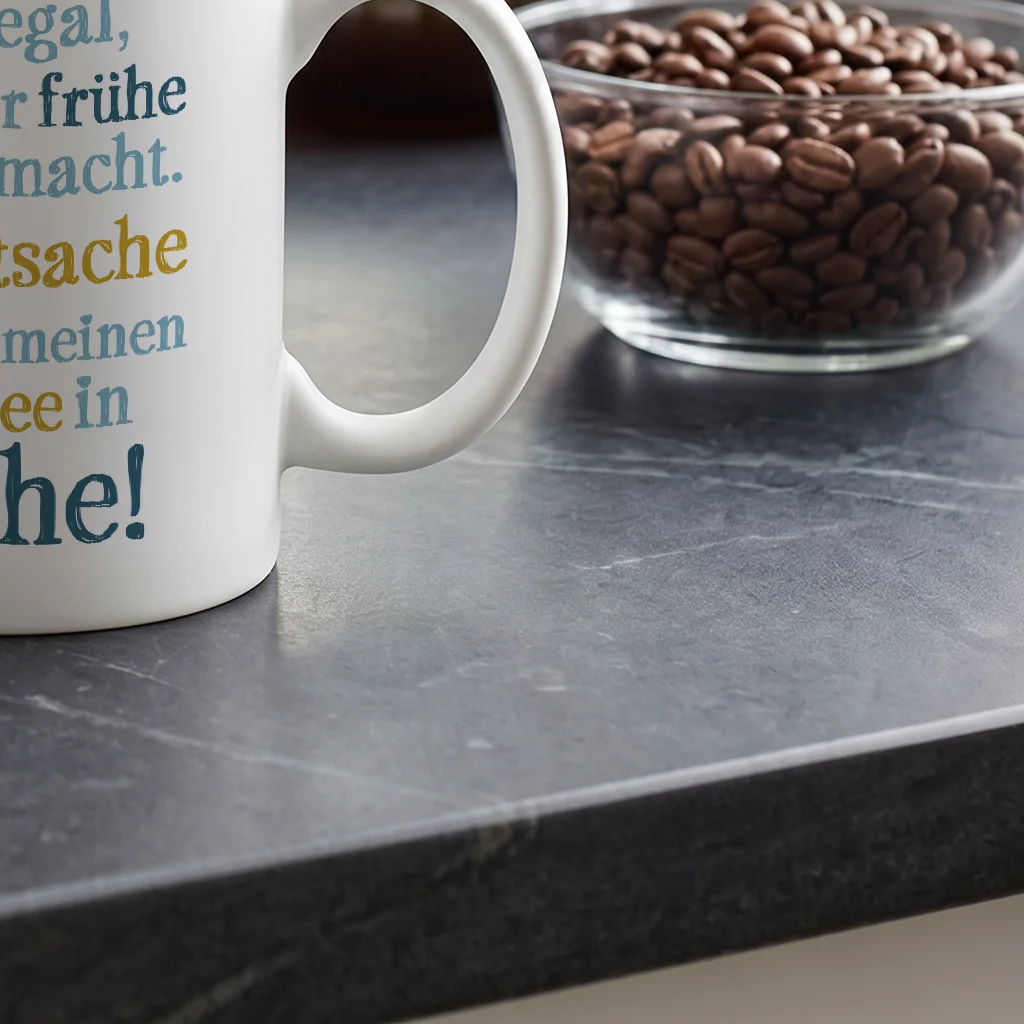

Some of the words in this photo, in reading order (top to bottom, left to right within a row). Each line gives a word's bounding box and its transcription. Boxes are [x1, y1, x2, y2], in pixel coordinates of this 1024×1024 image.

[38, 63, 187, 127] frühe
[0, 314, 188, 364] meinen
[75, 376, 134, 429] in
